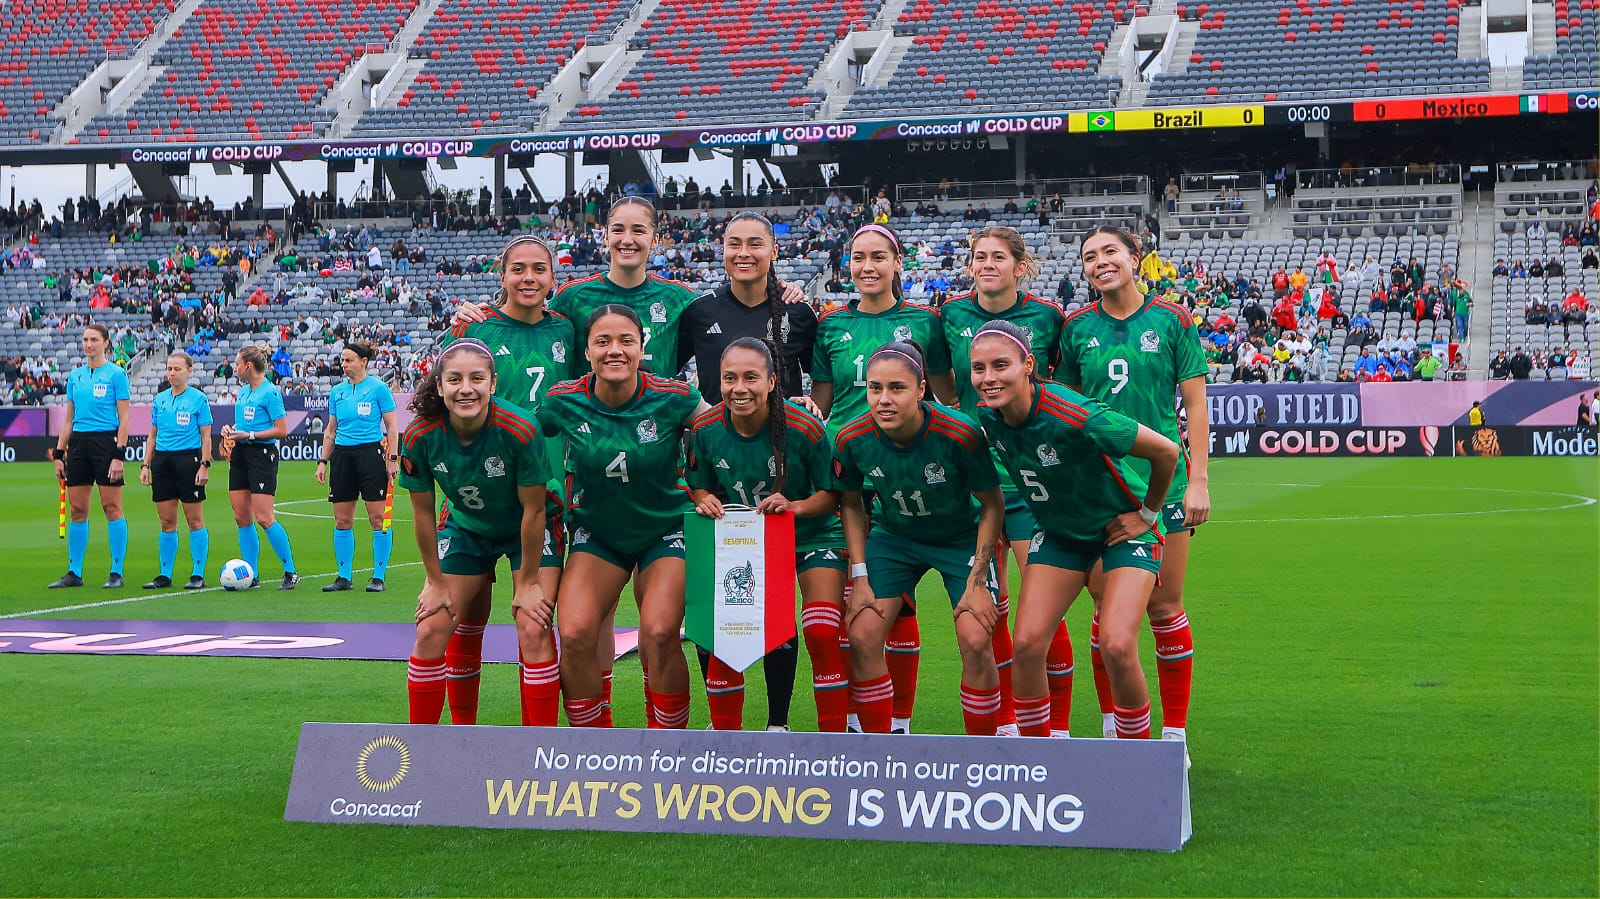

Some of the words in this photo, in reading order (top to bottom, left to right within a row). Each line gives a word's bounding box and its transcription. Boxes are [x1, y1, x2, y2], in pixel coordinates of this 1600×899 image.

[1153, 110, 1203, 129] Brazil
[1243, 109, 1253, 124] 0
[1288, 106, 1330, 121] 00:00
[1376, 104, 1385, 118] 0
[1423, 99, 1488, 118] Mexico
[699, 130, 761, 145] Concacaf
[782, 127, 822, 142] GOLD
[825, 125, 857, 139] CUP
[897, 121, 962, 136] Concacaf
[984, 118, 1027, 133] GOLD
[1030, 117, 1062, 131] CUP
[132, 148, 192, 162] Concacaf
[212, 146, 250, 160] GOLD
[253, 145, 282, 159] CUP
[321, 144, 381, 158] Concacaf
[402, 143, 442, 156] GOLD
[444, 142, 474, 155] CUP
[510, 138, 570, 152] Concacaf
[590, 135, 628, 149] GOLD
[631, 134, 661, 147] CUP
[853, 354, 867, 387] 1
[1108, 358, 1129, 394] 9
[526, 367, 545, 401] 7
[1206, 394, 1264, 425] HOR
[1276, 393, 1359, 425] FIELD
[1259, 430, 1340, 454] GOLD
[1346, 430, 1406, 454] CUP
[605, 452, 629, 483] 4
[1020, 469, 1050, 501] 5
[458, 486, 484, 510] 8
[892, 490, 931, 517] 11
[723, 538, 758, 546] SEMIFINAL
[534, 746, 569, 771] No
[574, 753, 643, 772] room
[649, 749, 685, 774] for
[691, 750, 878, 779] discrimination
[885, 755, 907, 779] in
[914, 762, 959, 780] our
[966, 763, 1048, 788] game
[329, 797, 422, 819] Concacaf
[486, 779, 643, 818] WHAT'S
[653, 783, 832, 825] WRONG
[847, 788, 885, 827] IS
[897, 790, 1085, 833] WRONG
